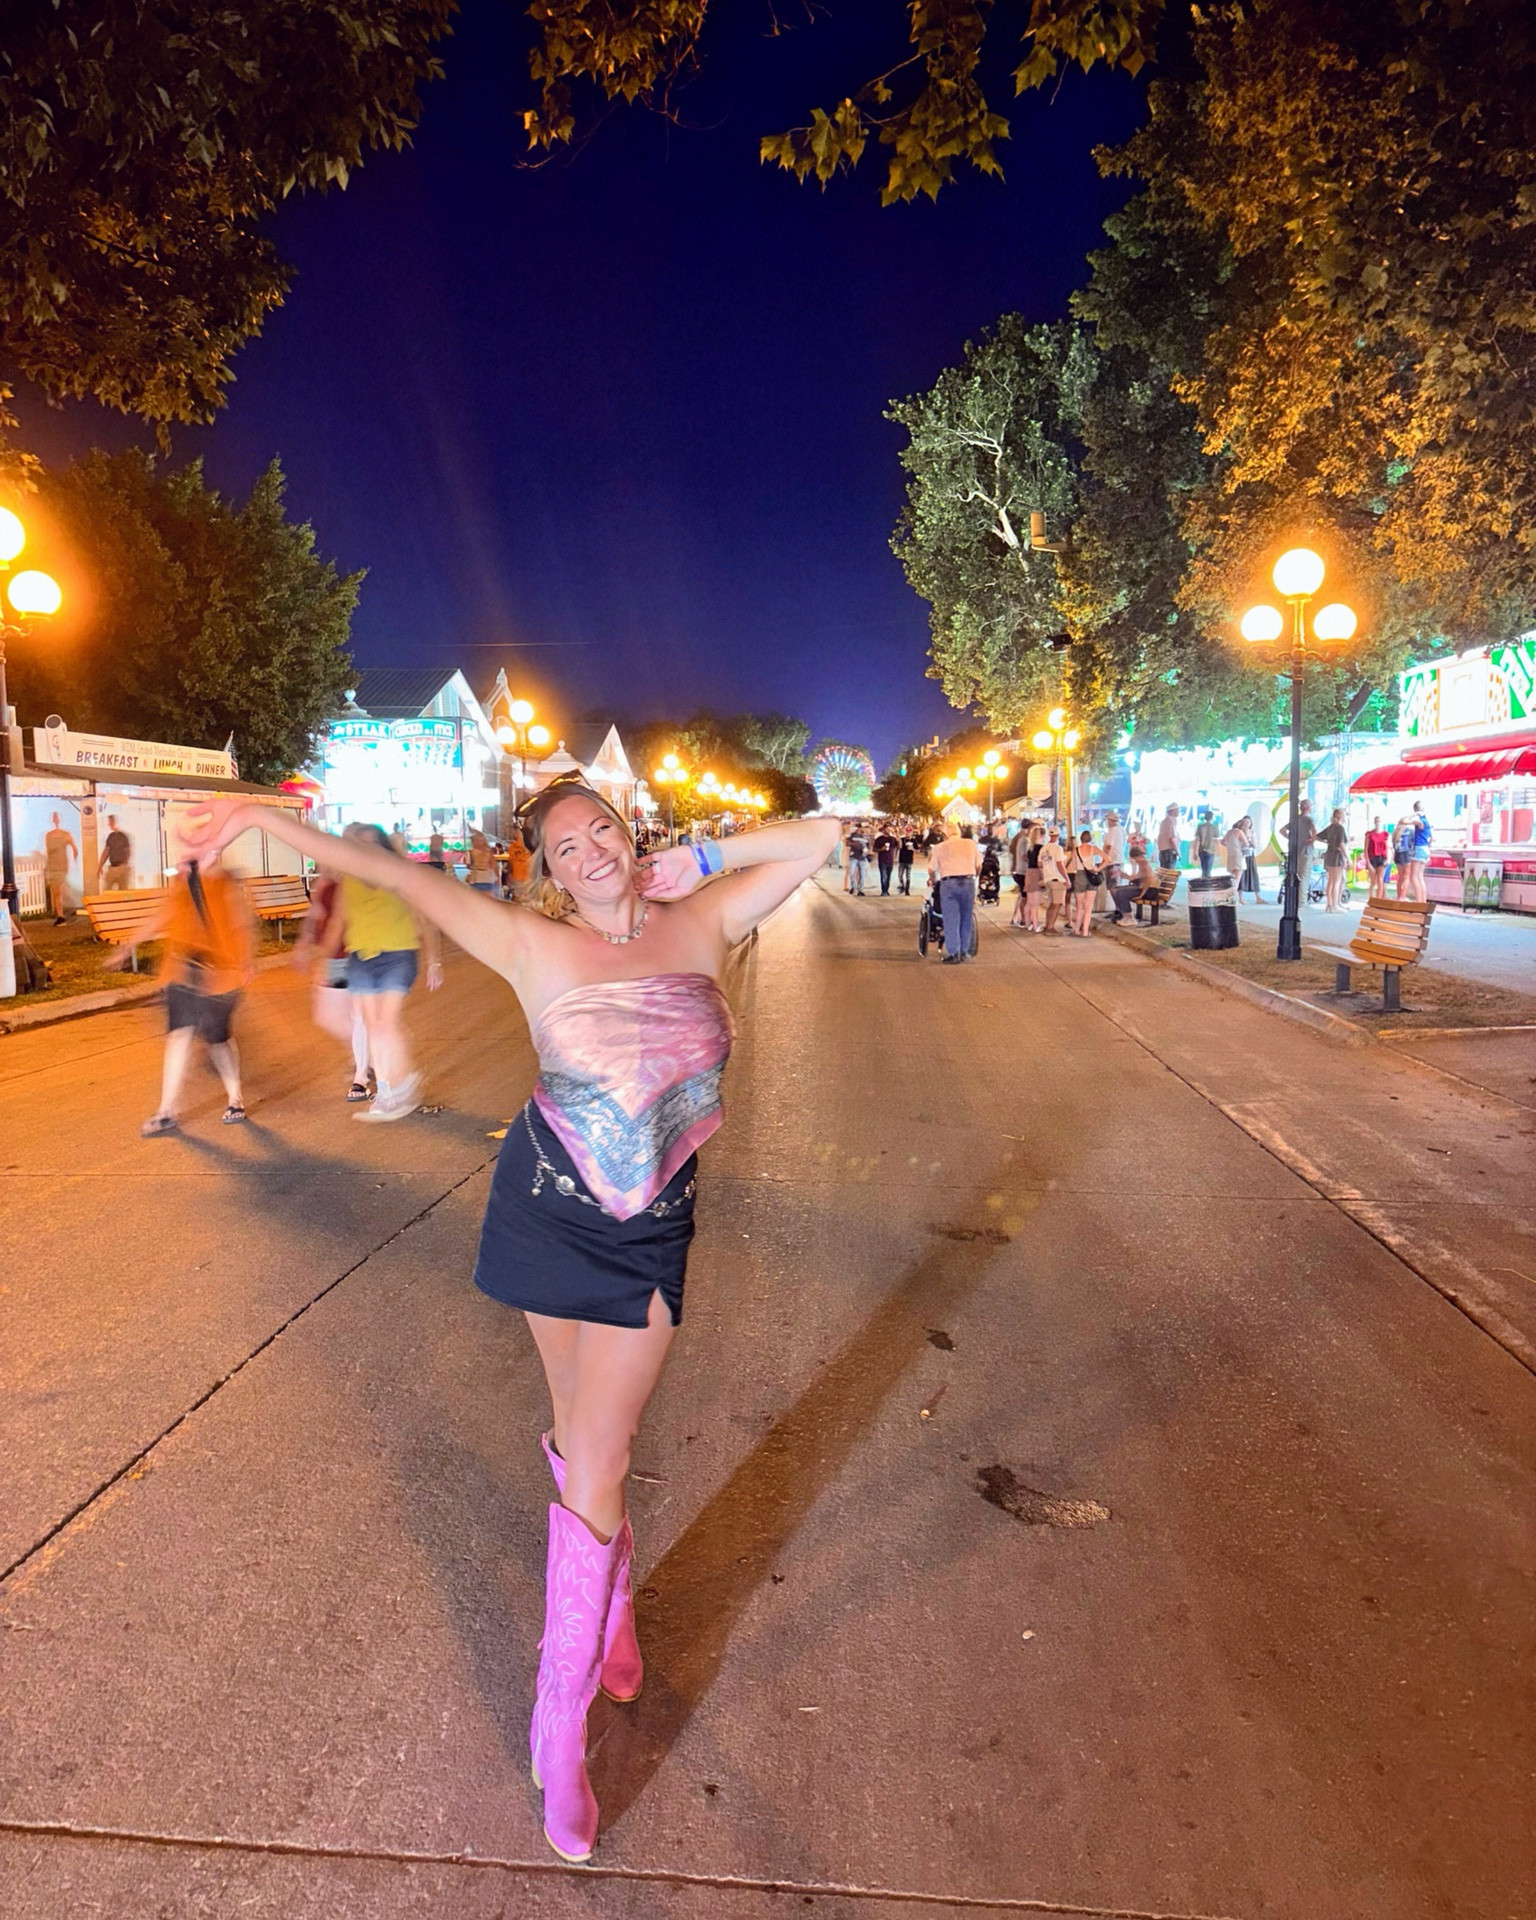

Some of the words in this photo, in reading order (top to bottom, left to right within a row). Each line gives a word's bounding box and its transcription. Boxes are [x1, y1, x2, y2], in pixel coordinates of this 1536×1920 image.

[346, 723, 388, 738] STEAK
[76, 750, 139, 768] BREAKFAST
[153, 758, 183, 772] LUNCH
[196, 763, 226, 776] DINNER
